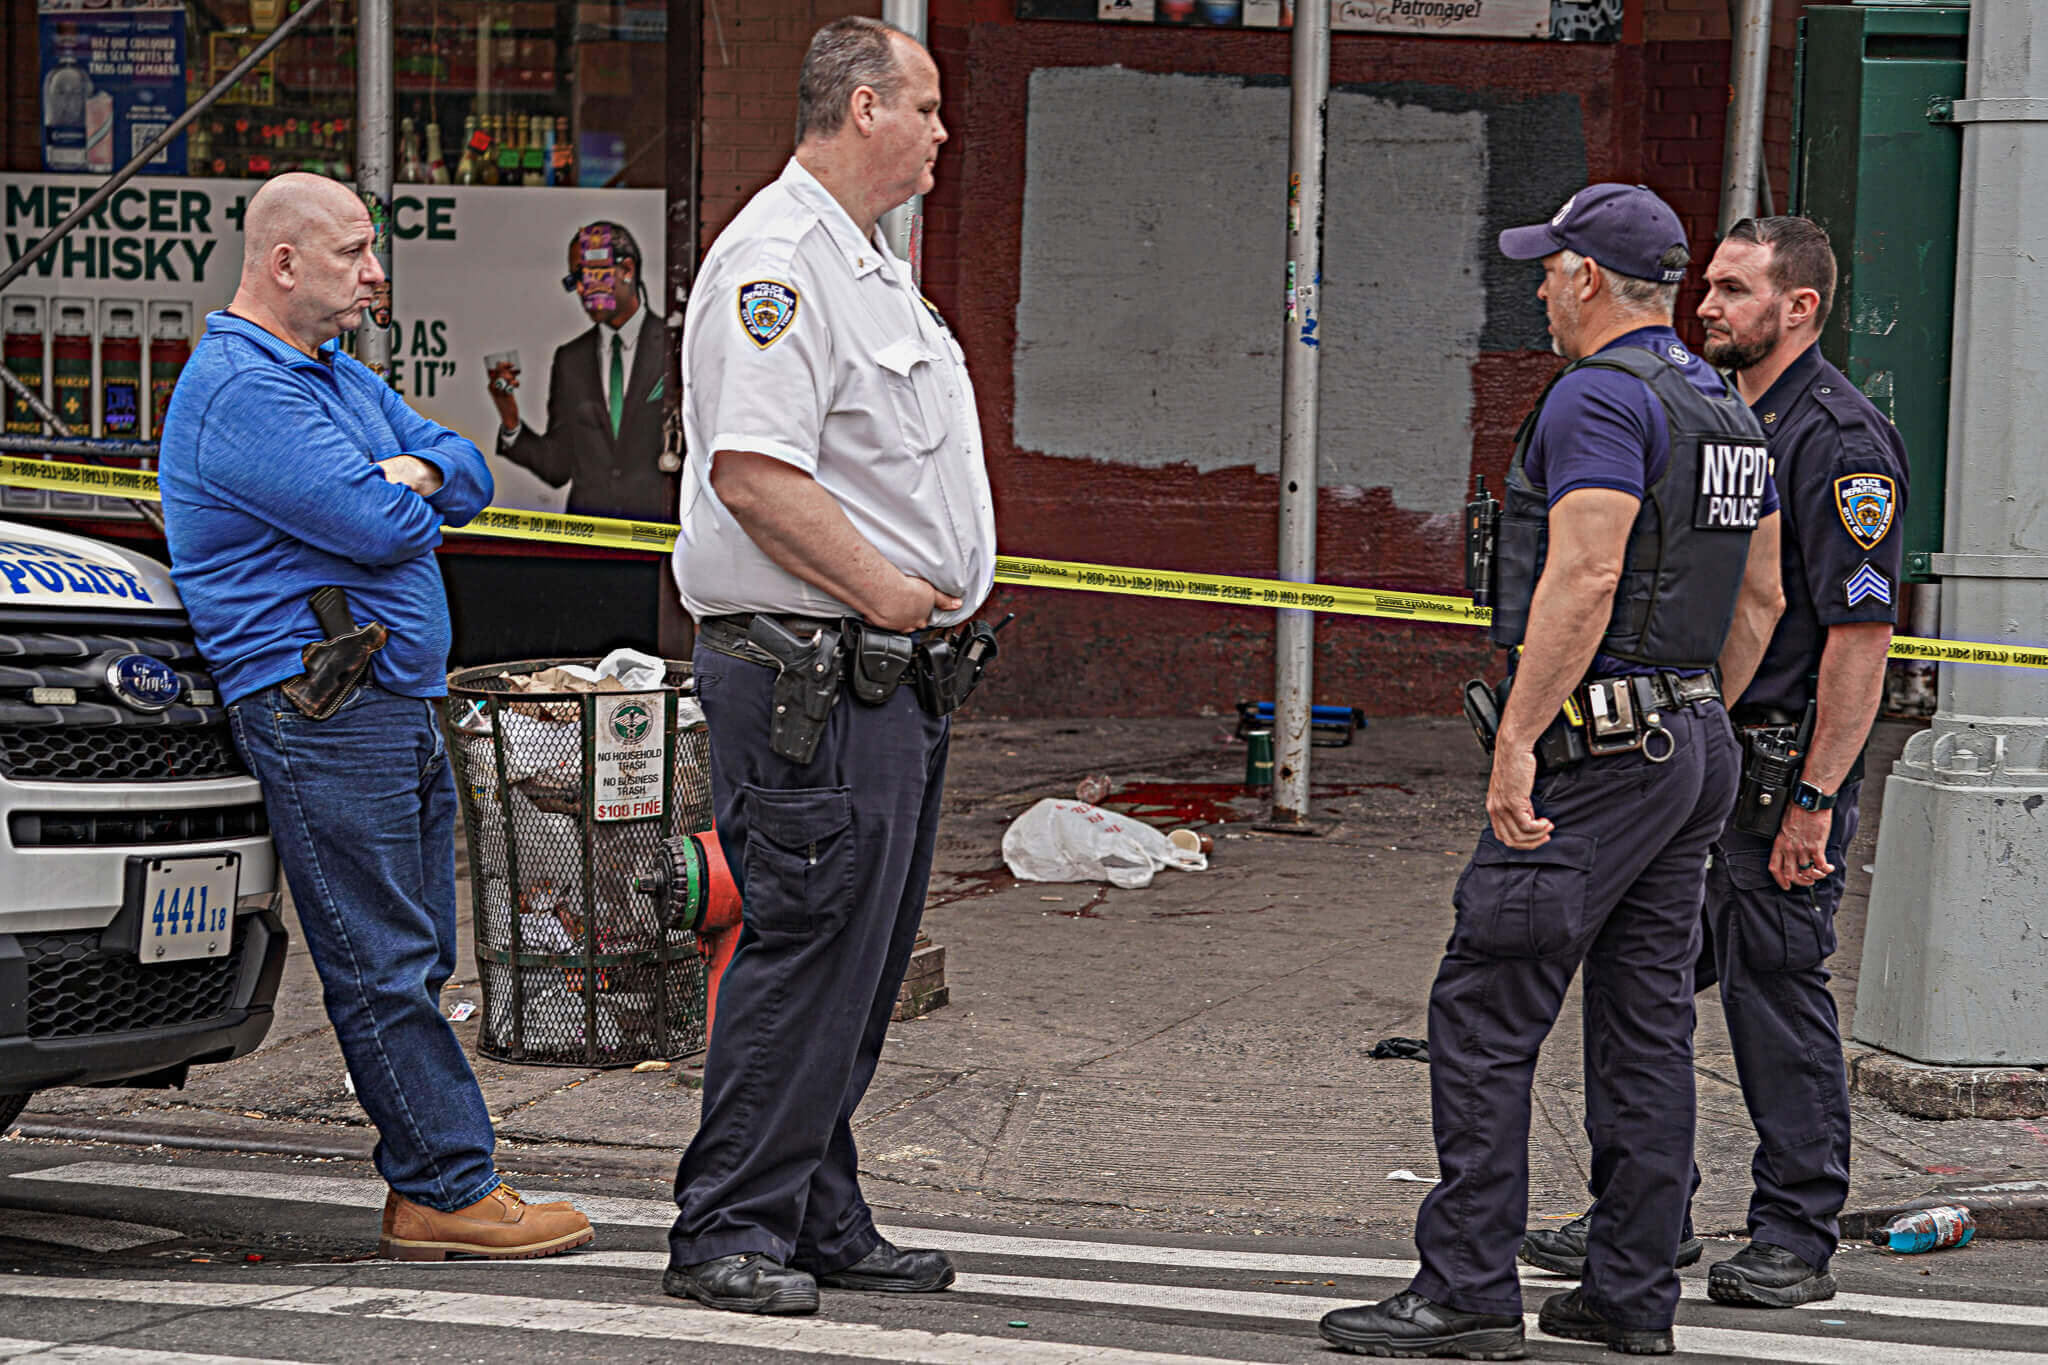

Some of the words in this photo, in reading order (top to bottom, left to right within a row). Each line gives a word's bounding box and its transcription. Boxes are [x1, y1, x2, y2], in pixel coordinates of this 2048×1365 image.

[1391, 0, 1481, 21] Patronage!
[6, 185, 212, 233] MERCER
[5, 234, 218, 282] WHISKY
[411, 320, 447, 357] AS
[1702, 444, 1768, 496] NYPD
[1852, 478, 1881, 488] POLICE
[1708, 496, 1761, 526] POLICE
[0, 559, 153, 604] POLICE
[597, 752, 611, 762] NO
[612, 748, 662, 761] HOUSEHOLD
[617, 760, 646, 771] TRASH
[603, 777, 616, 787] NO
[618, 773, 659, 786] BUSINESS
[617, 785, 646, 796] TRASH
[597, 804, 630, 818] $100
[633, 800, 662, 816] FINE
[152, 885, 208, 936] 4441
